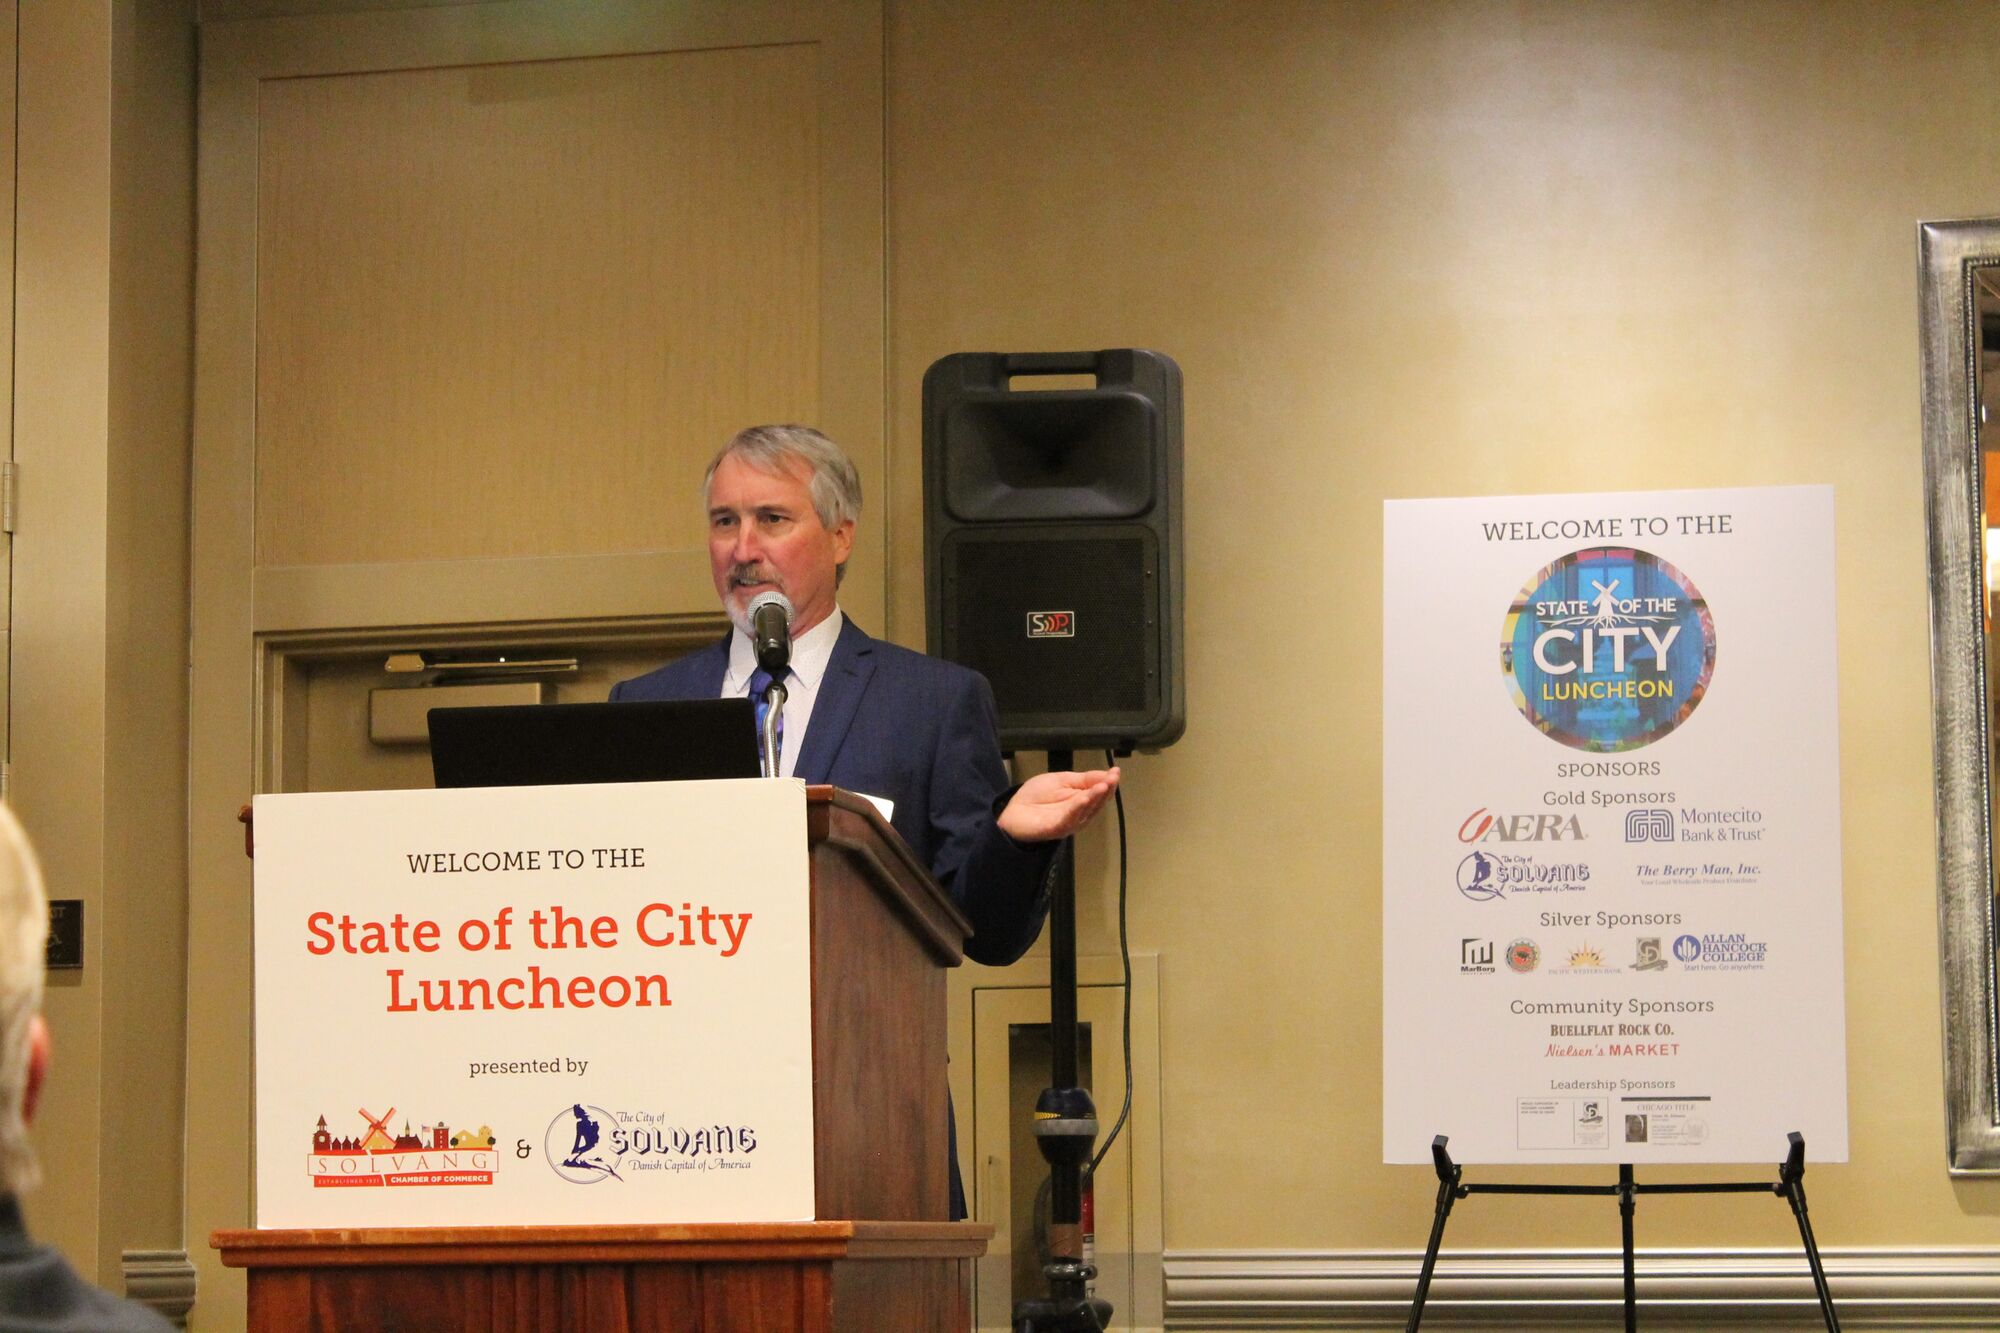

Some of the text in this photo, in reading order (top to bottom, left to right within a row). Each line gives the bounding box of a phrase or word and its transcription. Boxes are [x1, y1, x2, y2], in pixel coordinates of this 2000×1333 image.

[1482, 514, 1733, 542] WELCOME TO THE
[1536, 598, 1677, 617] STATE OF THE
[1532, 626, 1681, 675] CITY
[1543, 680, 1674, 701] LUNCHEON
[1557, 761, 1661, 778] SPONSORS
[1543, 790, 1676, 807] Gold Sponsors
[1681, 807, 1762, 824] Montecito
[1481, 813, 1585, 842] AERA
[1681, 827, 1762, 842] Bank & Trust
[407, 847, 645, 874] WELCOME TO THE
[1497, 863, 1590, 883] SOLVANG
[1636, 863, 1761, 878] The Berry Man, Inc.
[307, 902, 753, 956] State of the City
[1540, 911, 1682, 929] Silver Sponsors
[1702, 934, 1746, 944] ALLAN
[1702, 943, 1767, 953] HANCOCK
[1702, 952, 1765, 962] COLLEGE
[386, 966, 672, 1012] Luncheon
[1510, 998, 1714, 1016] Community Sponsors
[1550, 1023, 1614, 1037] BUELLFLAT
[1618, 1023, 1650, 1036] ROCK
[1544, 1043, 1680, 1057] Nielsen's MARKET
[469, 1058, 588, 1078] presented by
[1550, 1079, 1676, 1092] Leadership Sponsors
[616, 1111, 665, 1125] The City of
[516, 1139, 532, 1160] &
[609, 1125, 757, 1157] SOLVANG
[318, 1153, 488, 1174] SOLVANG
[628, 1158, 751, 1173] Danish Capital of America
[391, 1176, 430, 1184] CHAMBER
[444, 1175, 488, 1183] COMMERCE
